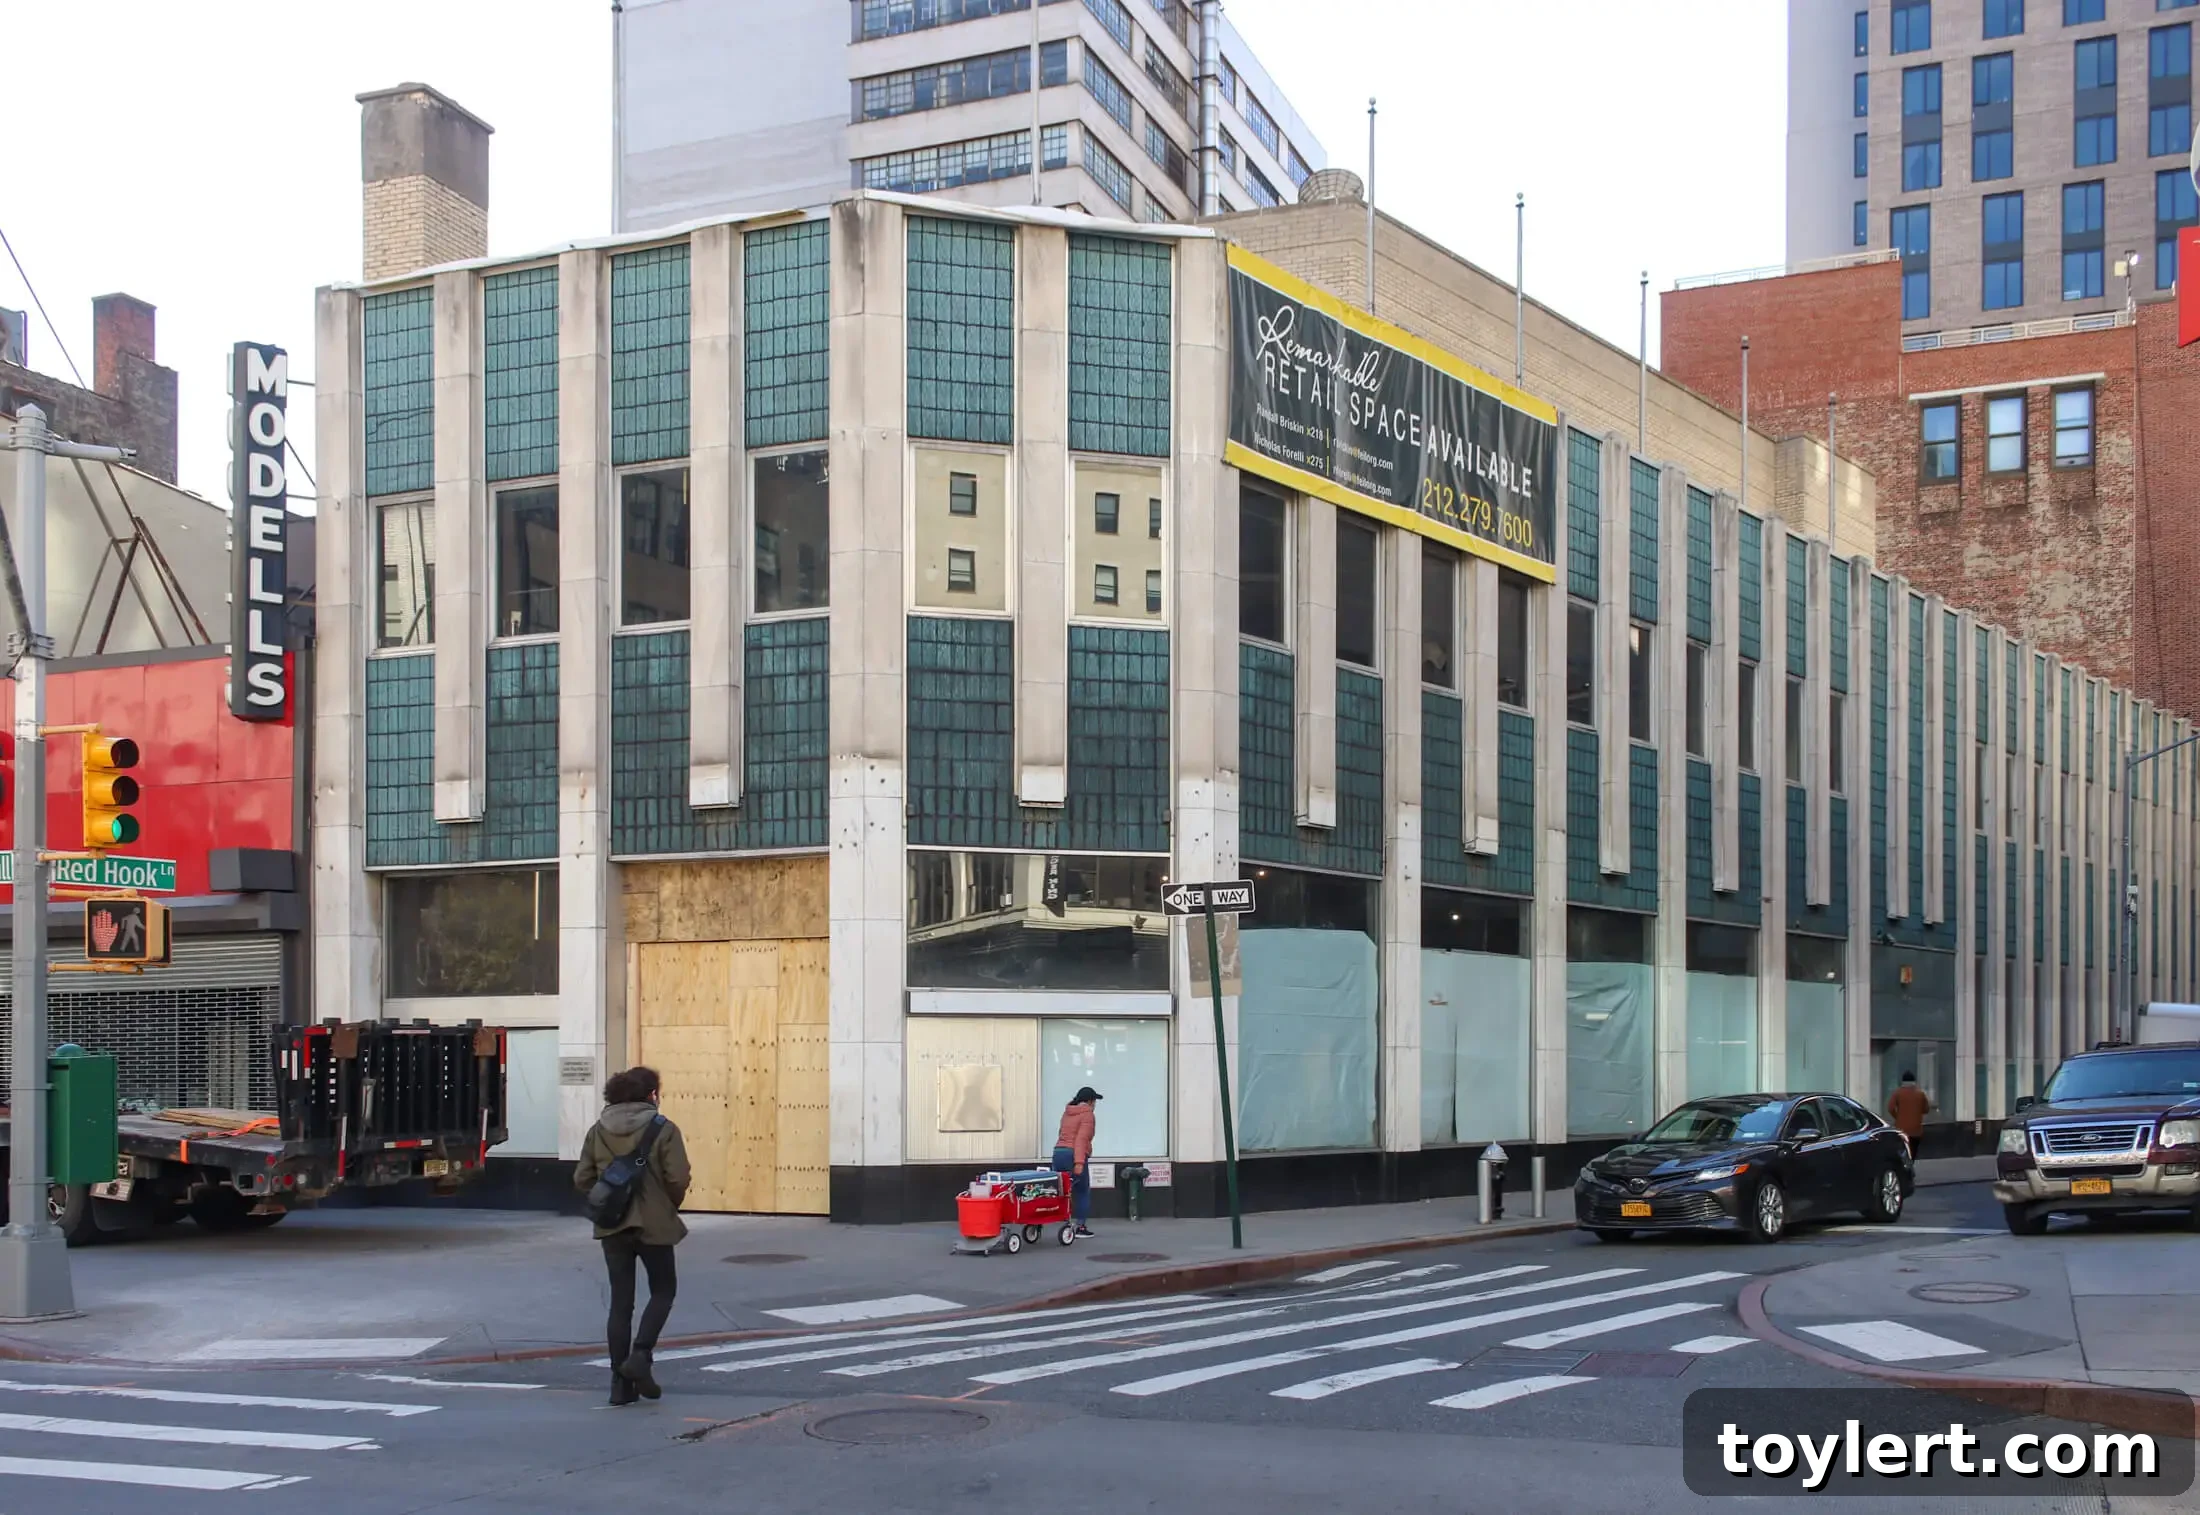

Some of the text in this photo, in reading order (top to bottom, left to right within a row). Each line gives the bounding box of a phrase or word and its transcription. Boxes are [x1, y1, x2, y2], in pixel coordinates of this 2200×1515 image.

[1256, 305, 1382, 392] Remarkable
[1254, 431, 1281, 455] Nicholas
[1282, 445, 1304, 463] Forelli
[1306, 455, 1323, 469] x275
[1265, 350, 1532, 498] RETAIL SPACE AVAILABLE
[1280, 415, 1304, 435] Briskin
[246, 348, 286, 706] MODELLS
[1423, 478, 1532, 547] 212.279.7600
[57, 858, 175, 887] Red Hook Ln
[1173, 890, 1244, 905] ONE WAY
